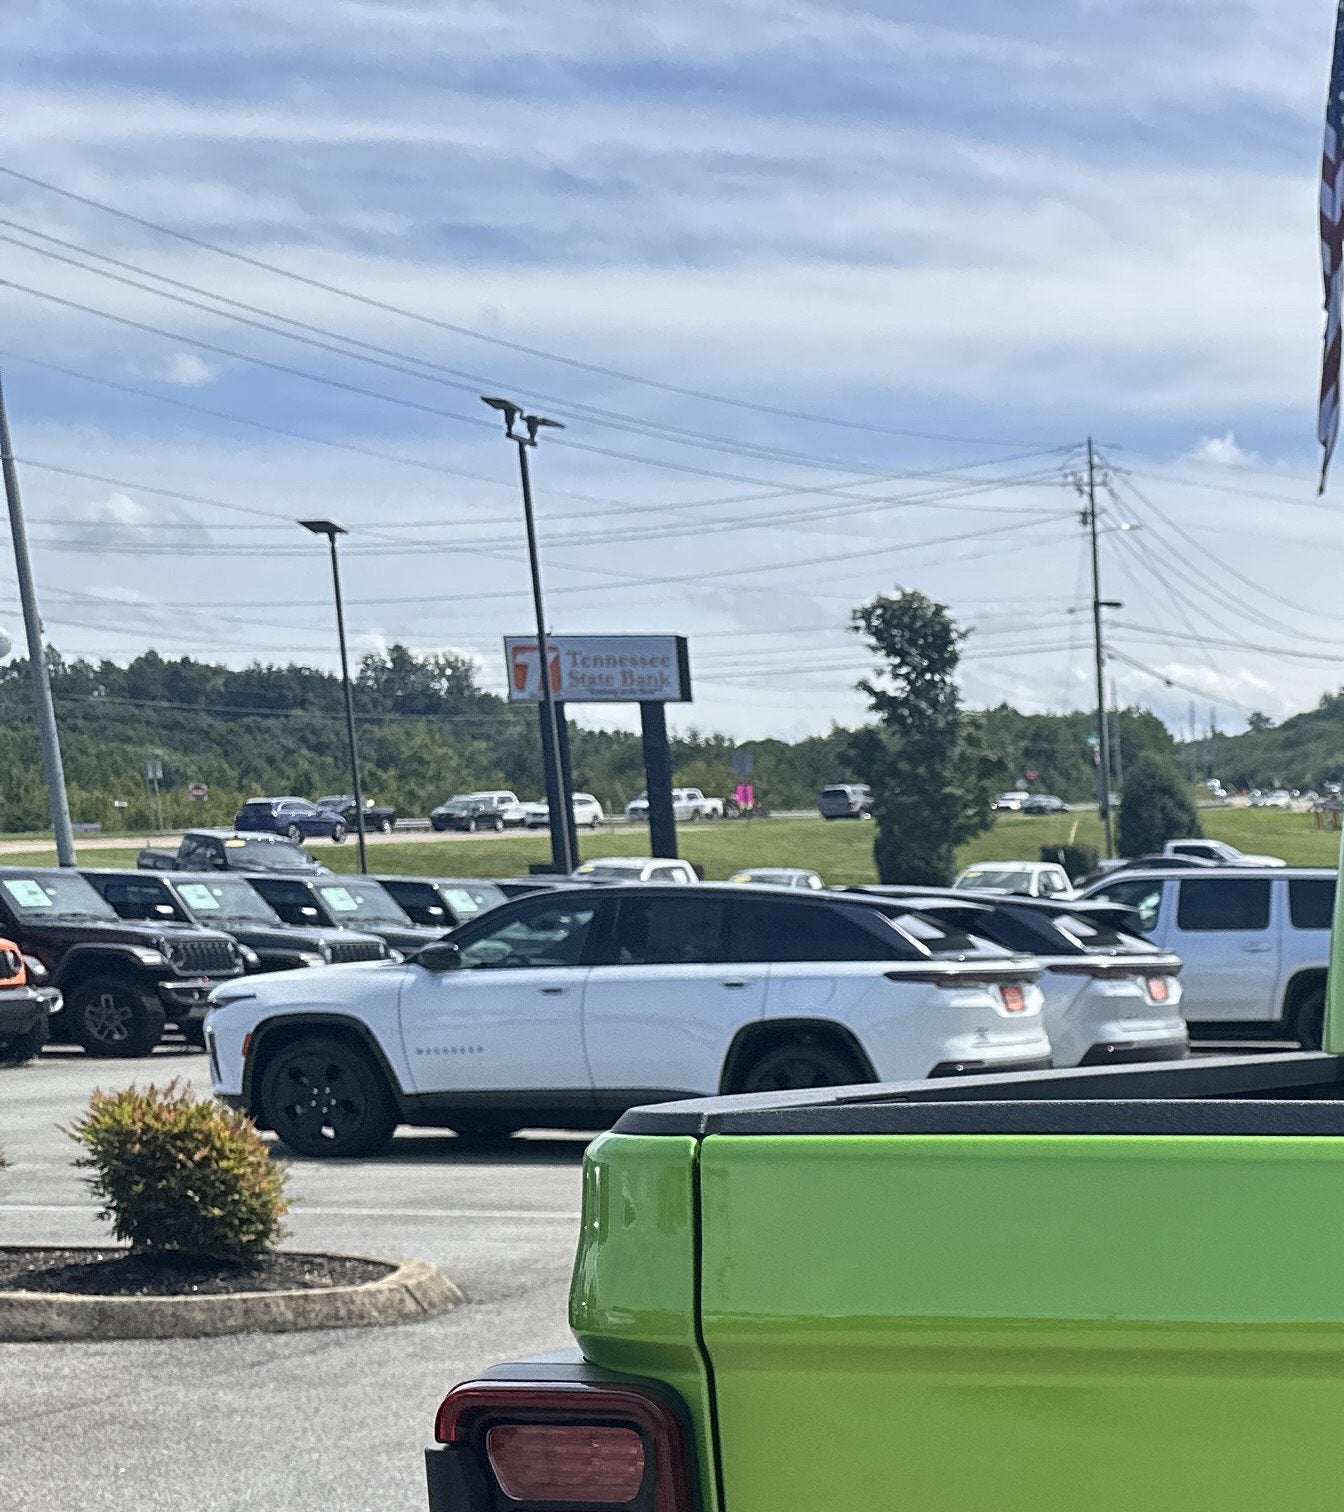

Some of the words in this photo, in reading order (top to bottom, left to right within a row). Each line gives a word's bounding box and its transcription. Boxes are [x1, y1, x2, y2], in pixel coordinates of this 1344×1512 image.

[566, 650, 671, 669] Tennessee
[567, 670, 614, 689] State
[620, 668, 671, 688] Bank
